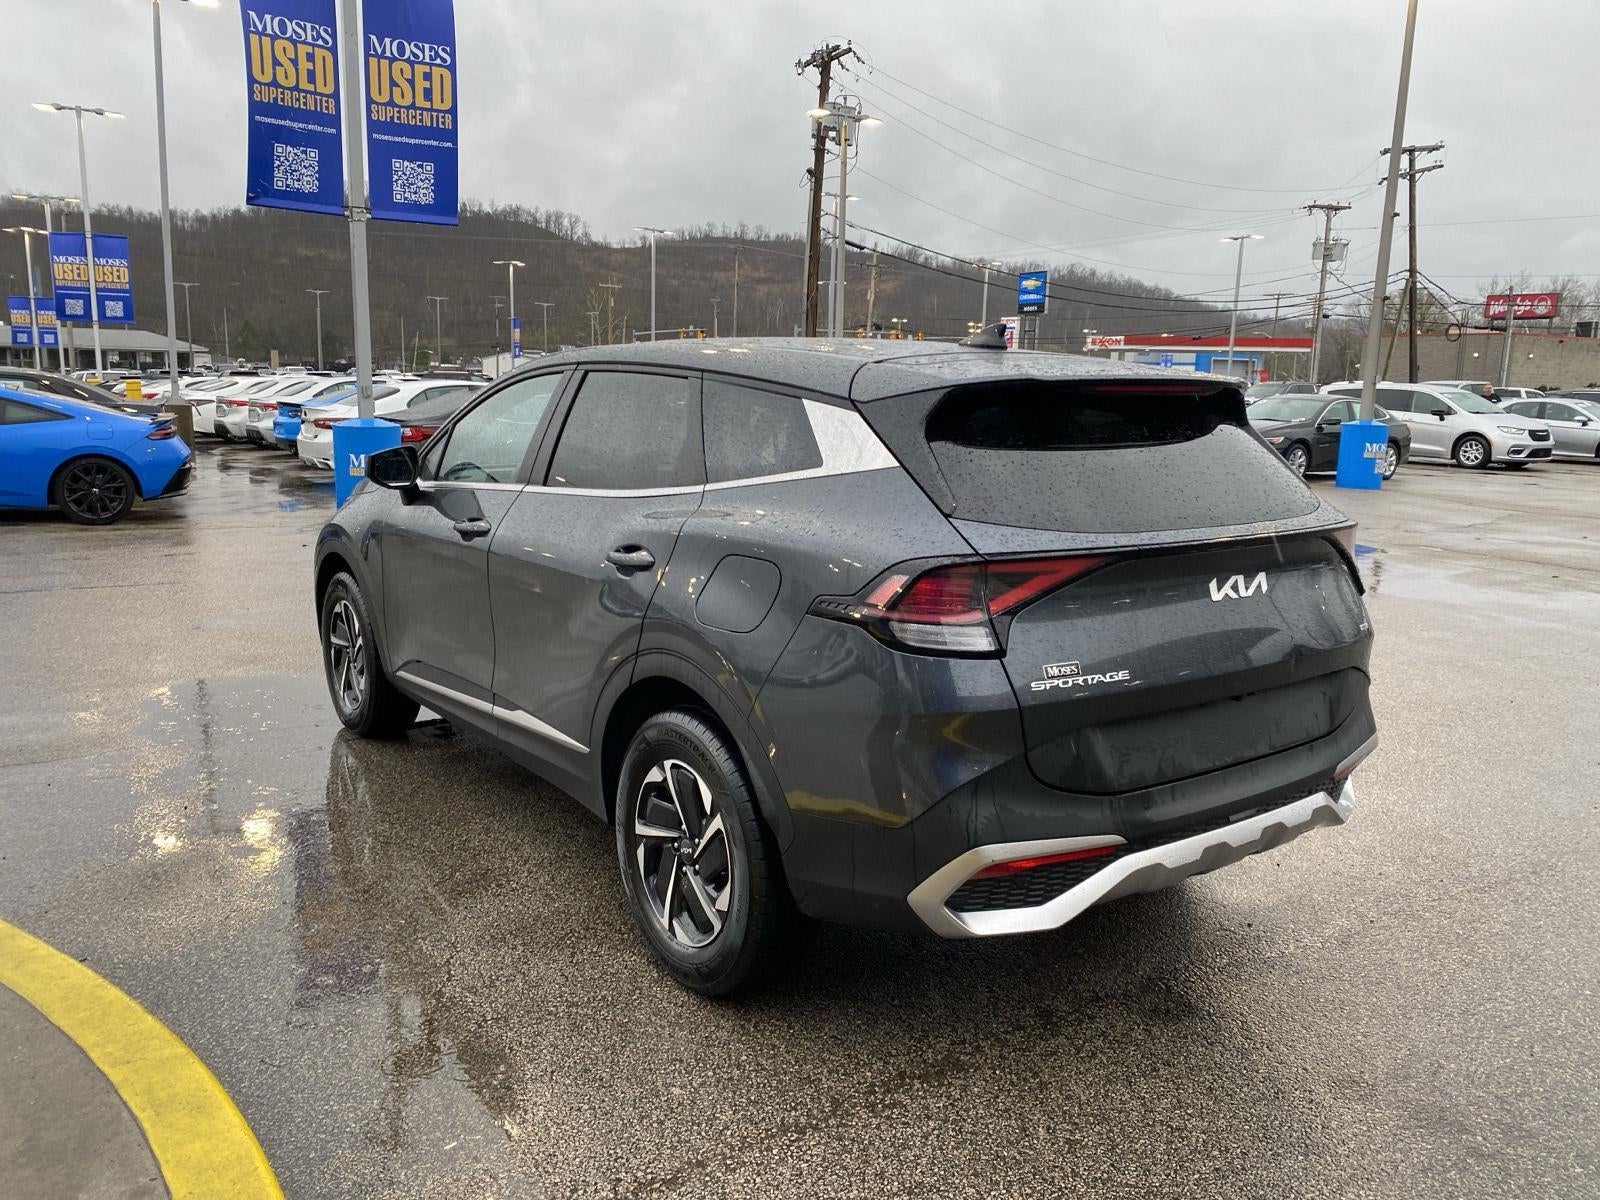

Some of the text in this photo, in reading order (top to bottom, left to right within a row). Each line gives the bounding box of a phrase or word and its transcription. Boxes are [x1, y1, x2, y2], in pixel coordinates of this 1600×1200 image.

[247, 10, 333, 47] MOSES
[368, 33, 451, 66] MOSES
[249, 33, 335, 95] USED
[368, 57, 452, 111] USED
[253, 83, 336, 115] SUPERCENTER
[254, 115, 337, 135] mosesusedsupercenter.com
[370, 104, 452, 129] SUPERCENTER
[372, 132, 454, 149] mosesusedsupercenter.com
[52, 255, 88, 264] MOSES
[95, 257, 128, 267] MOSES
[53, 263, 89, 281] USED
[95, 265, 129, 283] USED
[1091, 336, 1121, 349] EXXON
[1208, 571, 1268, 602] KIA
[1030, 670, 1130, 690] SPORTAGE
[1047, 665, 1078, 677] MOSES
